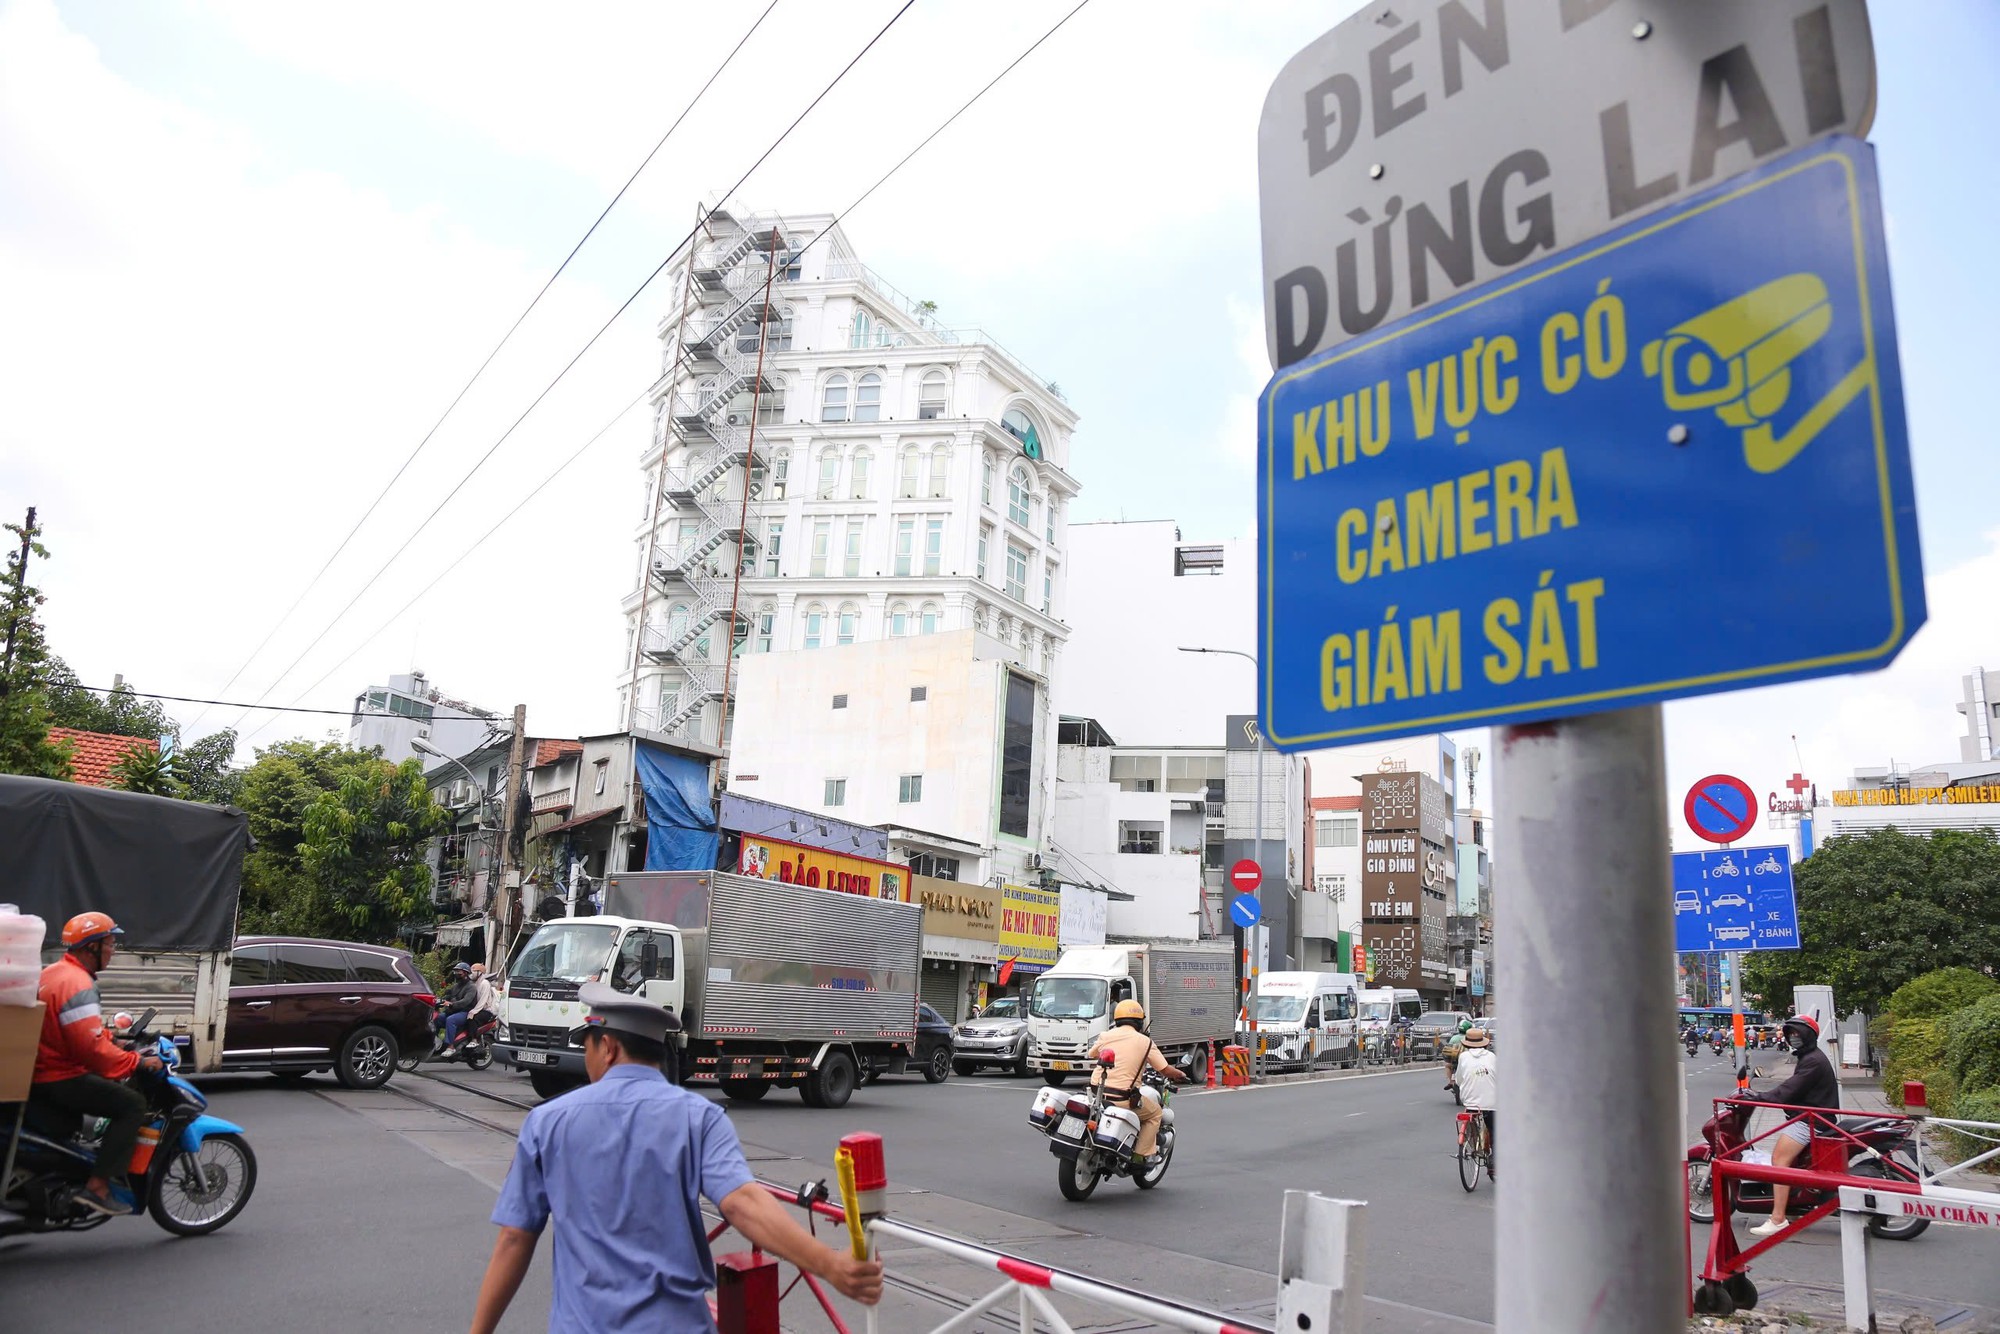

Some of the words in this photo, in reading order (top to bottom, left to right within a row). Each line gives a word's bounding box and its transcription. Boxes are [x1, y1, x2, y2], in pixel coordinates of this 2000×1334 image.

[1274, 148, 1557, 369] DỪNG
[1292, 380, 1391, 480] KHU
[1408, 334, 1520, 445] VỰC
[1540, 278, 1628, 395] CÓ
[1335, 446, 1579, 585] CAMERA
[1320, 605, 1462, 712] GIÁM
[1482, 570, 1605, 685] SÁT
[1861, 788, 1897, 806] KHOA
[1899, 787, 1944, 805] HAPPY
[1946, 785, 1989, 804] SMILE
[1366, 836, 1389, 854] ẢNH
[1390, 836, 1415, 856] VIỆN
[779, 852, 821, 888] BẢO
[827, 869, 872, 897] LINH
[1367, 858, 1386, 873] GIA
[1388, 855, 1415, 873] ĐÌNH
[1387, 881, 1396, 895] &
[1369, 898, 1392, 916] TRẺ
[1394, 901, 1413, 916] EM
[1767, 911, 1780, 921] XE
[1002, 908, 1013, 932] XE
[1014, 905, 1031, 934] MÁY
[1758, 928, 1764, 938] 2
[1766, 925, 1792, 938] BÁNH
[530, 991, 554, 1000] ISUZU
[1903, 1201, 1936, 1218] DÀN
[1940, 1205, 1989, 1225] CHẮN
